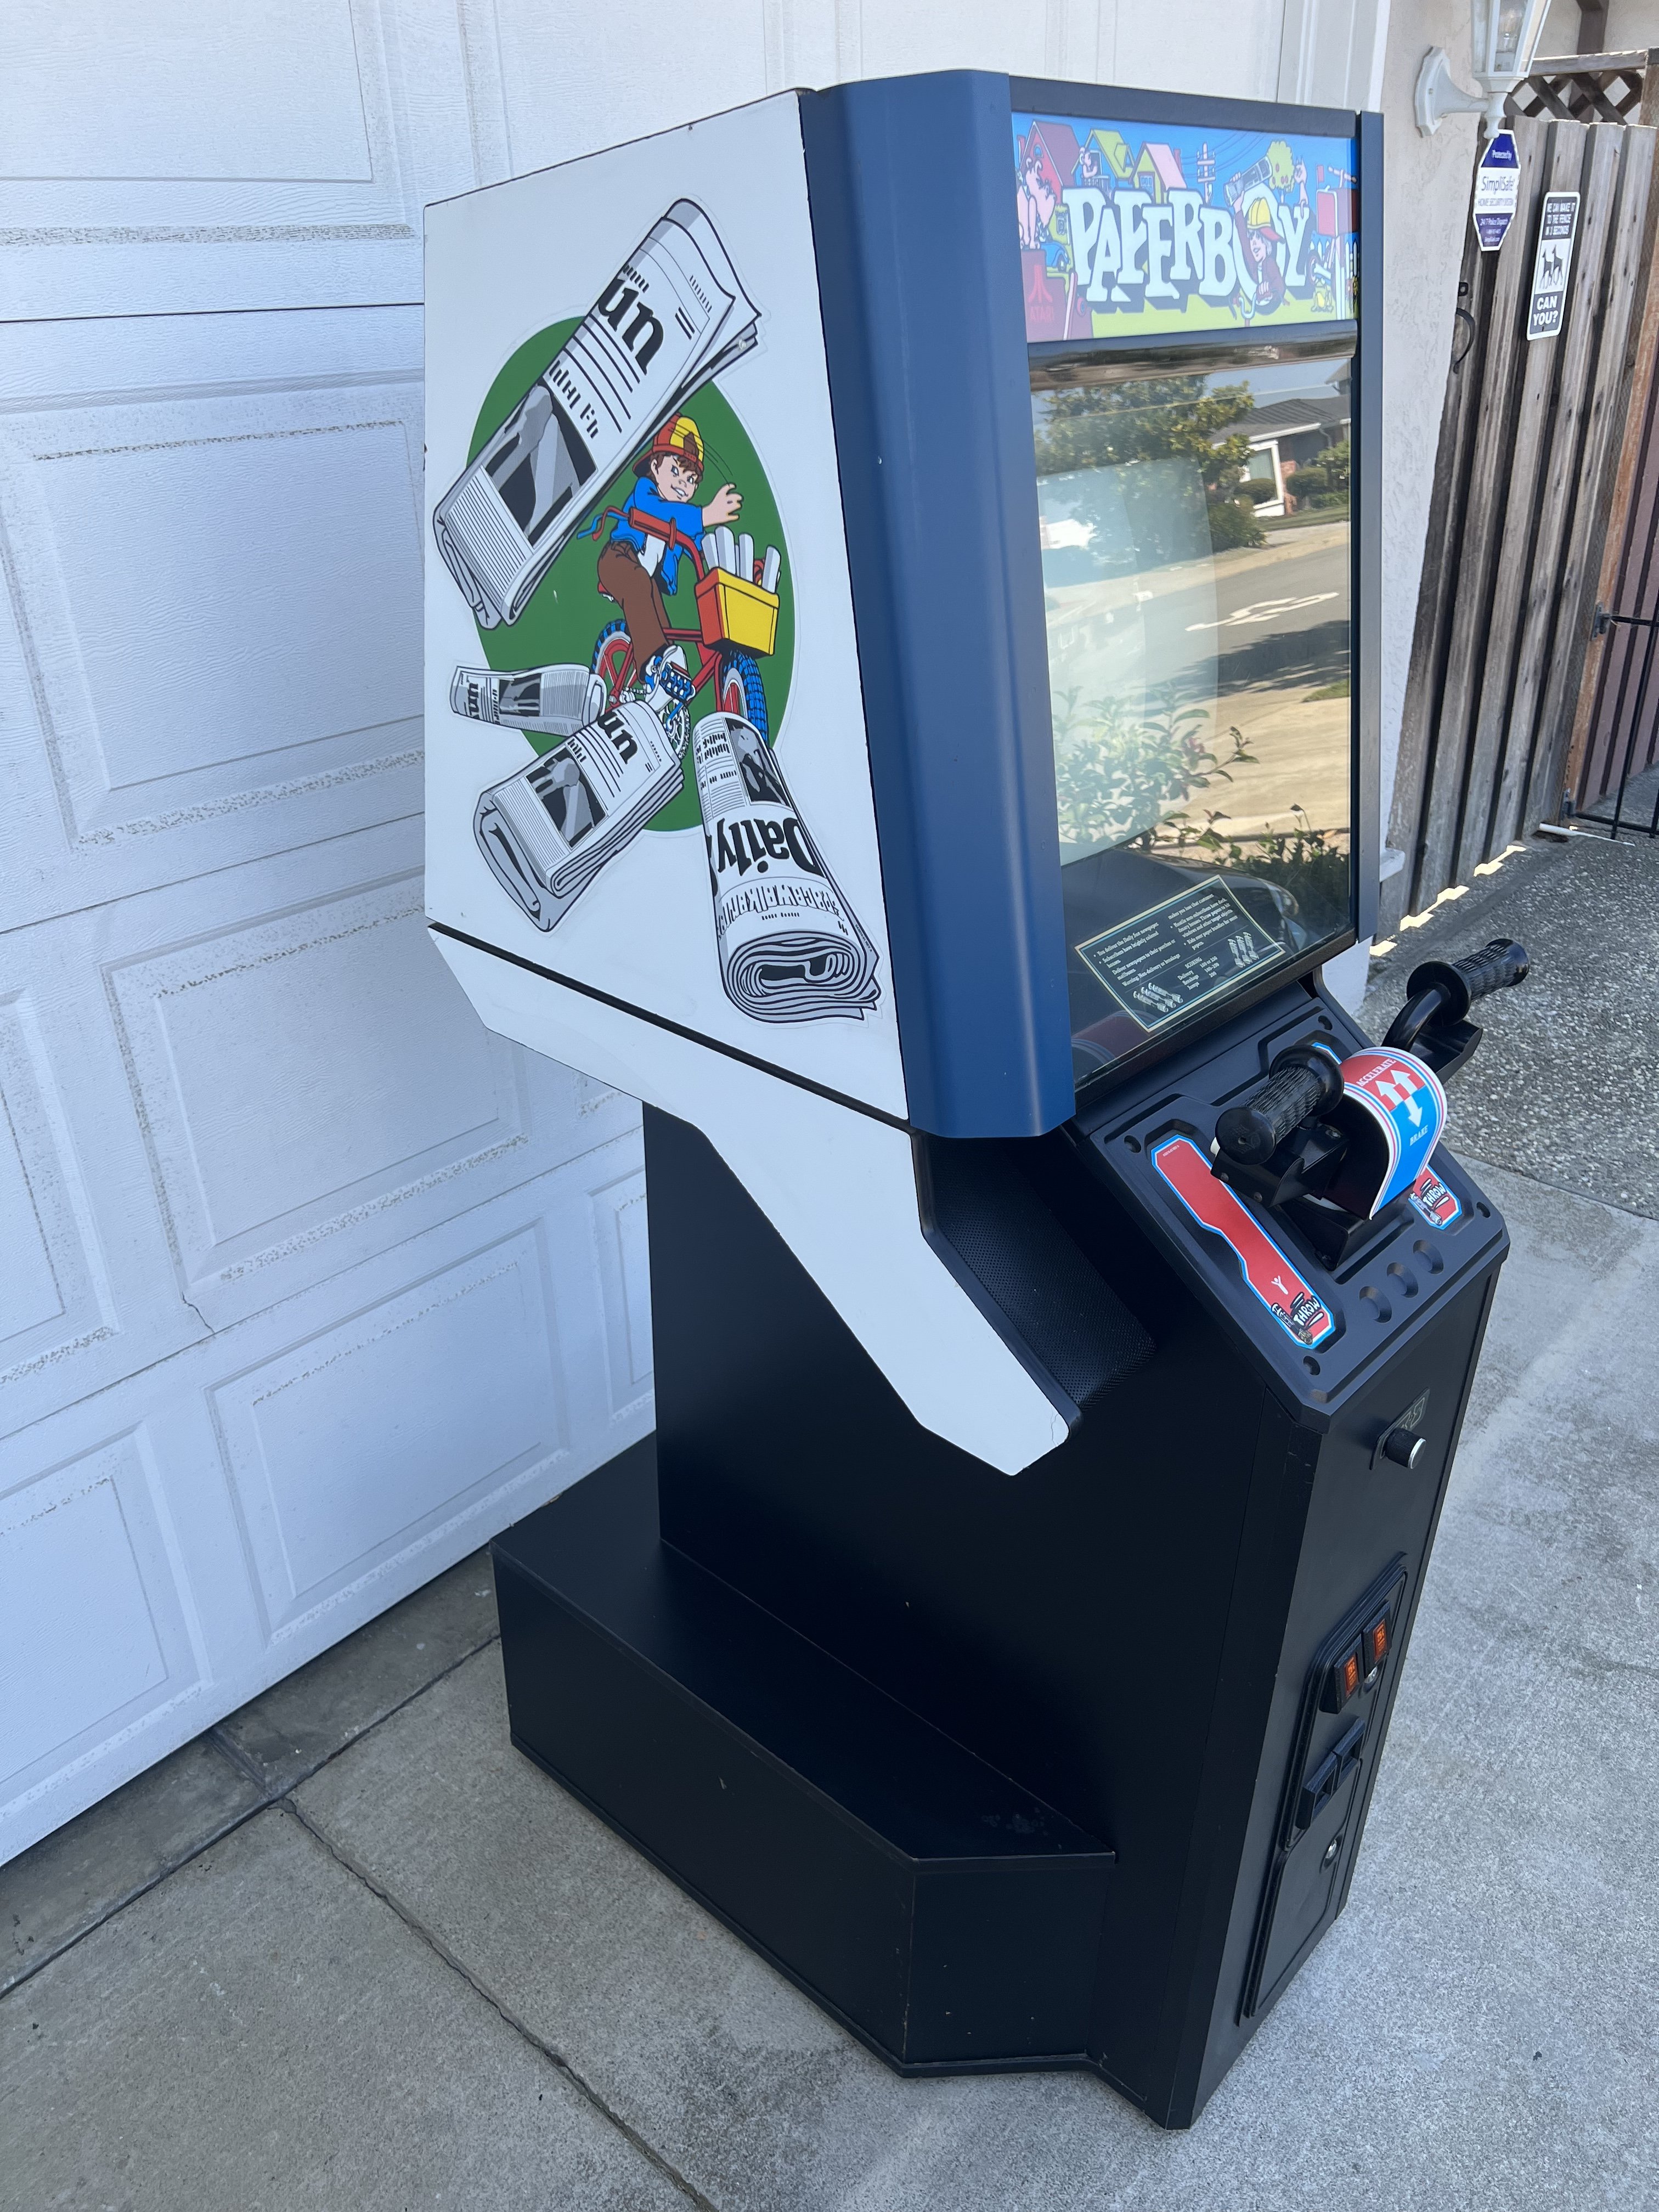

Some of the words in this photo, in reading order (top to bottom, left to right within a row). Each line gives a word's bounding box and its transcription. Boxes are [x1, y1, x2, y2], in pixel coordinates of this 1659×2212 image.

[1481, 176, 1514, 195] SimpliSafe
[1062, 182, 1310, 302] PAPERBOY
[1537, 295, 1558, 311] CAN
[1533, 310, 1558, 326] YOU?
[717, 817, 823, 877] Daily
[1184, 956, 1202, 968] SCORING
[1356, 1058, 1397, 1086] ACCELERATE
[1409, 1125, 1428, 1146] BRAKE
[1422, 1182, 1447, 1207] THROW
[1293, 1296, 1321, 1326] THROW
